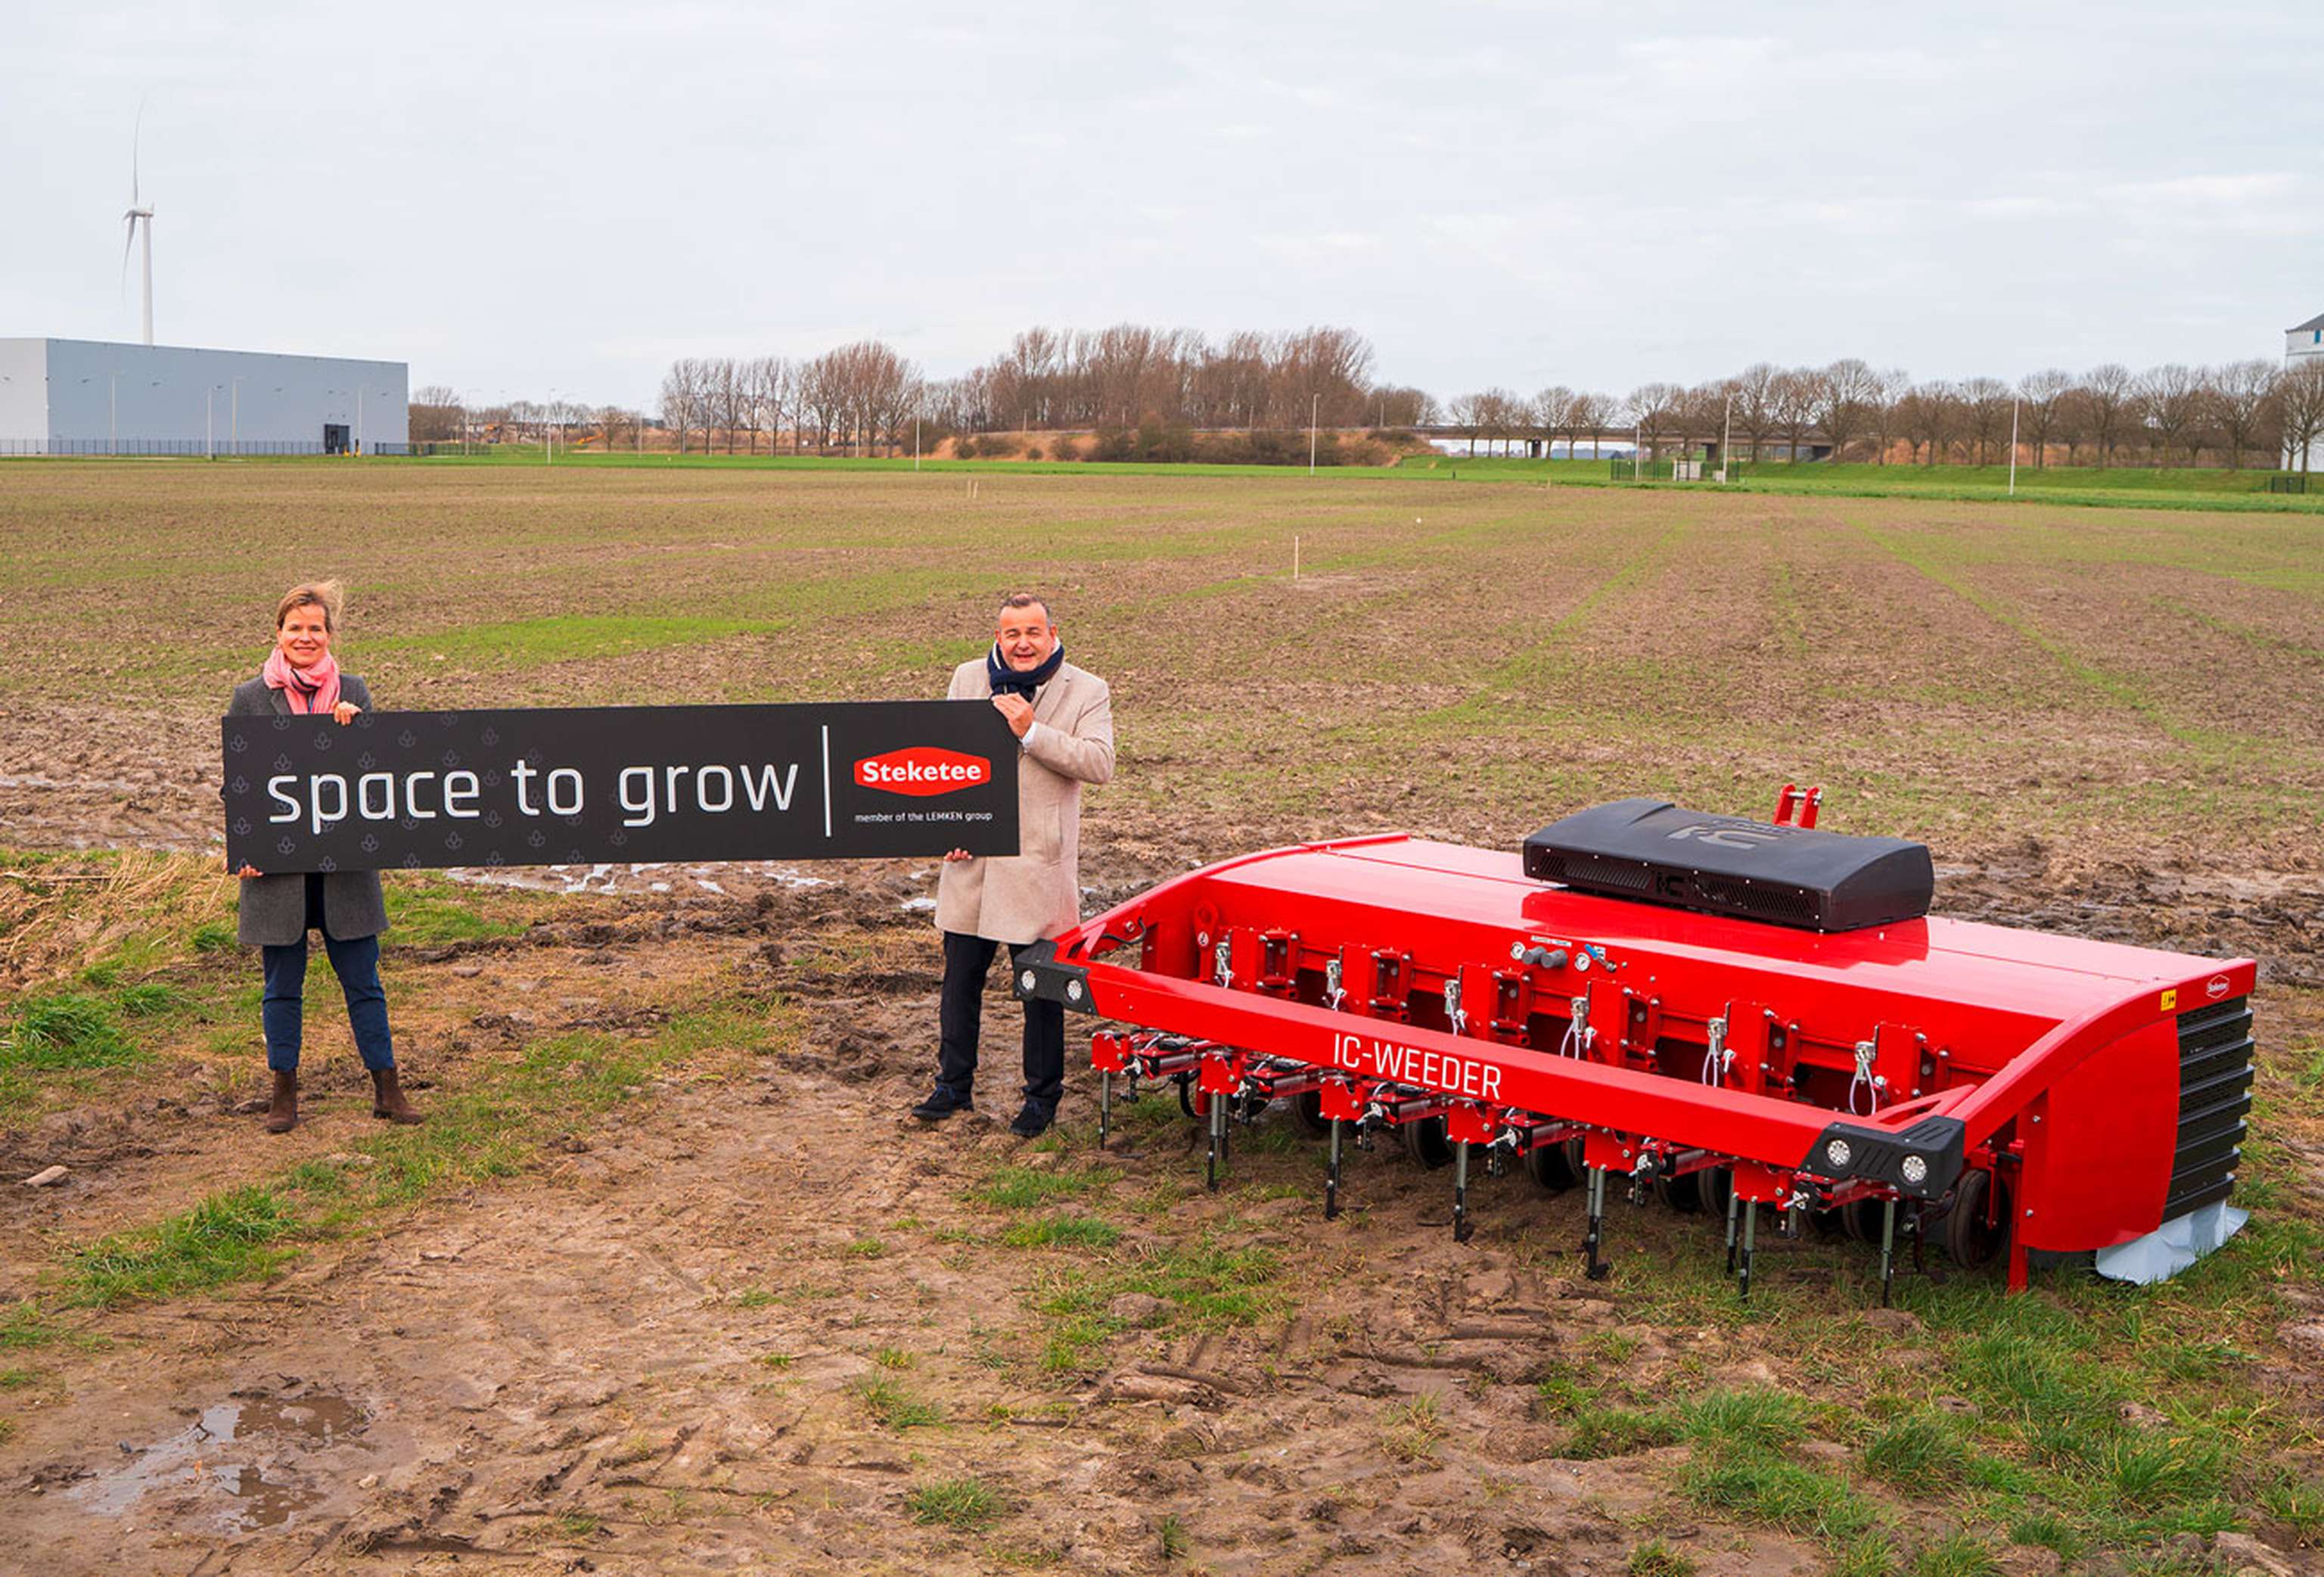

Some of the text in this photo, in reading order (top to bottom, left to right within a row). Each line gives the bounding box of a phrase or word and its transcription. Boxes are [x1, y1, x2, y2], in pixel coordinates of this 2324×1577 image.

[862, 761, 982, 783] Steketee
[267, 759, 799, 835] space to grow
[855, 811, 993, 823] member of the LEMKEN group
[1334, 1033, 1502, 1100] IC-WEEDER
